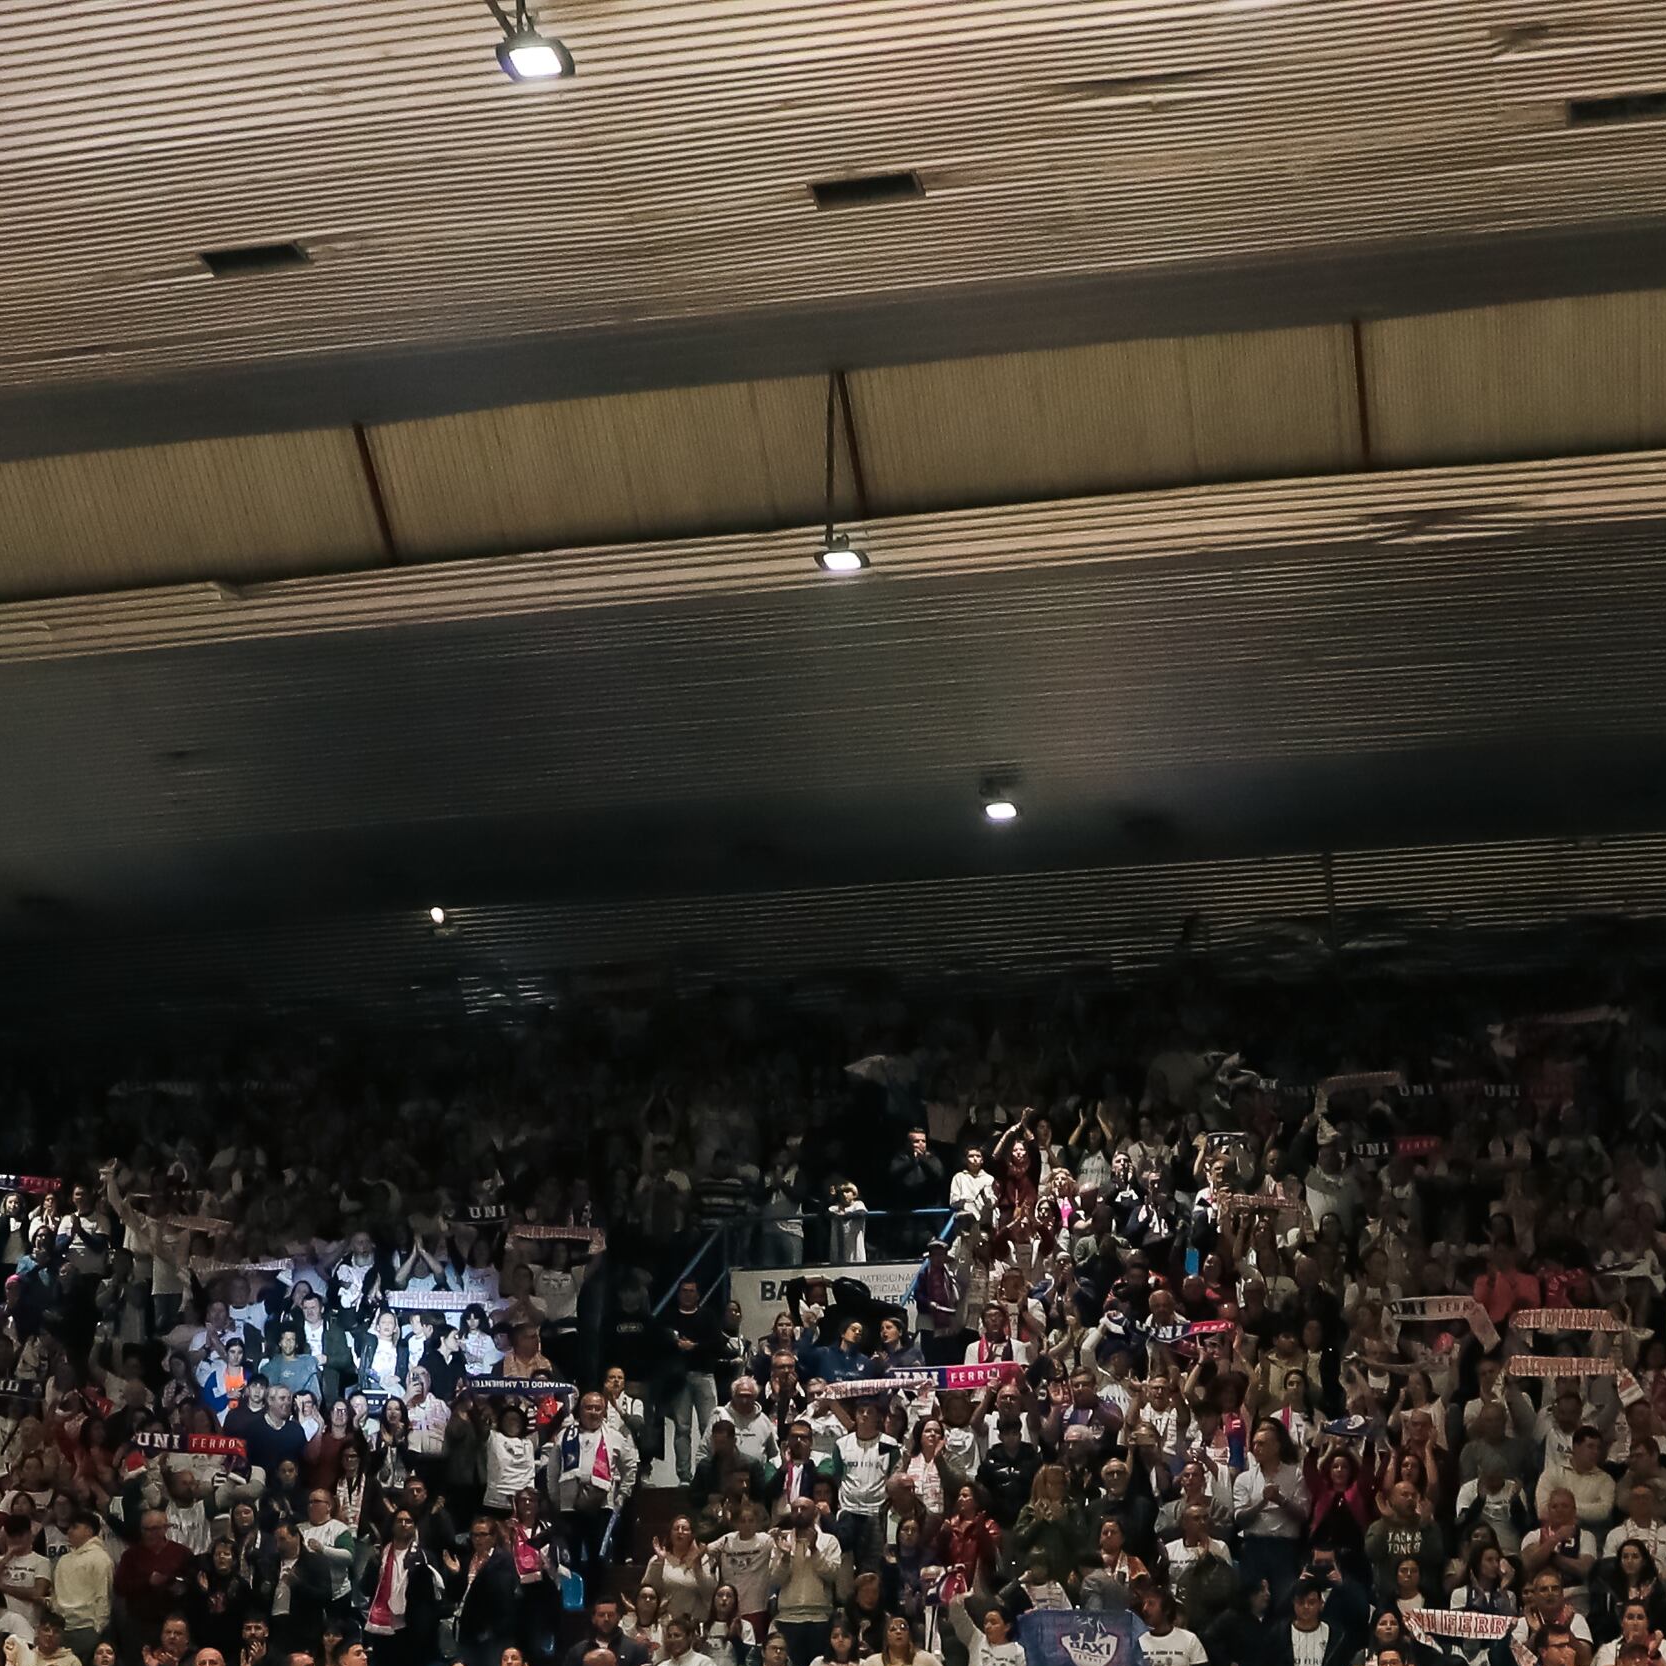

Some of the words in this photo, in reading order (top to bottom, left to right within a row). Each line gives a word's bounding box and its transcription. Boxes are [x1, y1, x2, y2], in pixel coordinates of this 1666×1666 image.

[1352, 1142, 1389, 1155] UNI
[468, 1205, 507, 1219] UNI
[760, 1280, 789, 1302] BA
[519, 1380, 530, 1389] EL
[135, 1432, 182, 1449] UNI
[1441, 1614, 1507, 1634] FERR
[1069, 1641, 1111, 1656] BAXI
